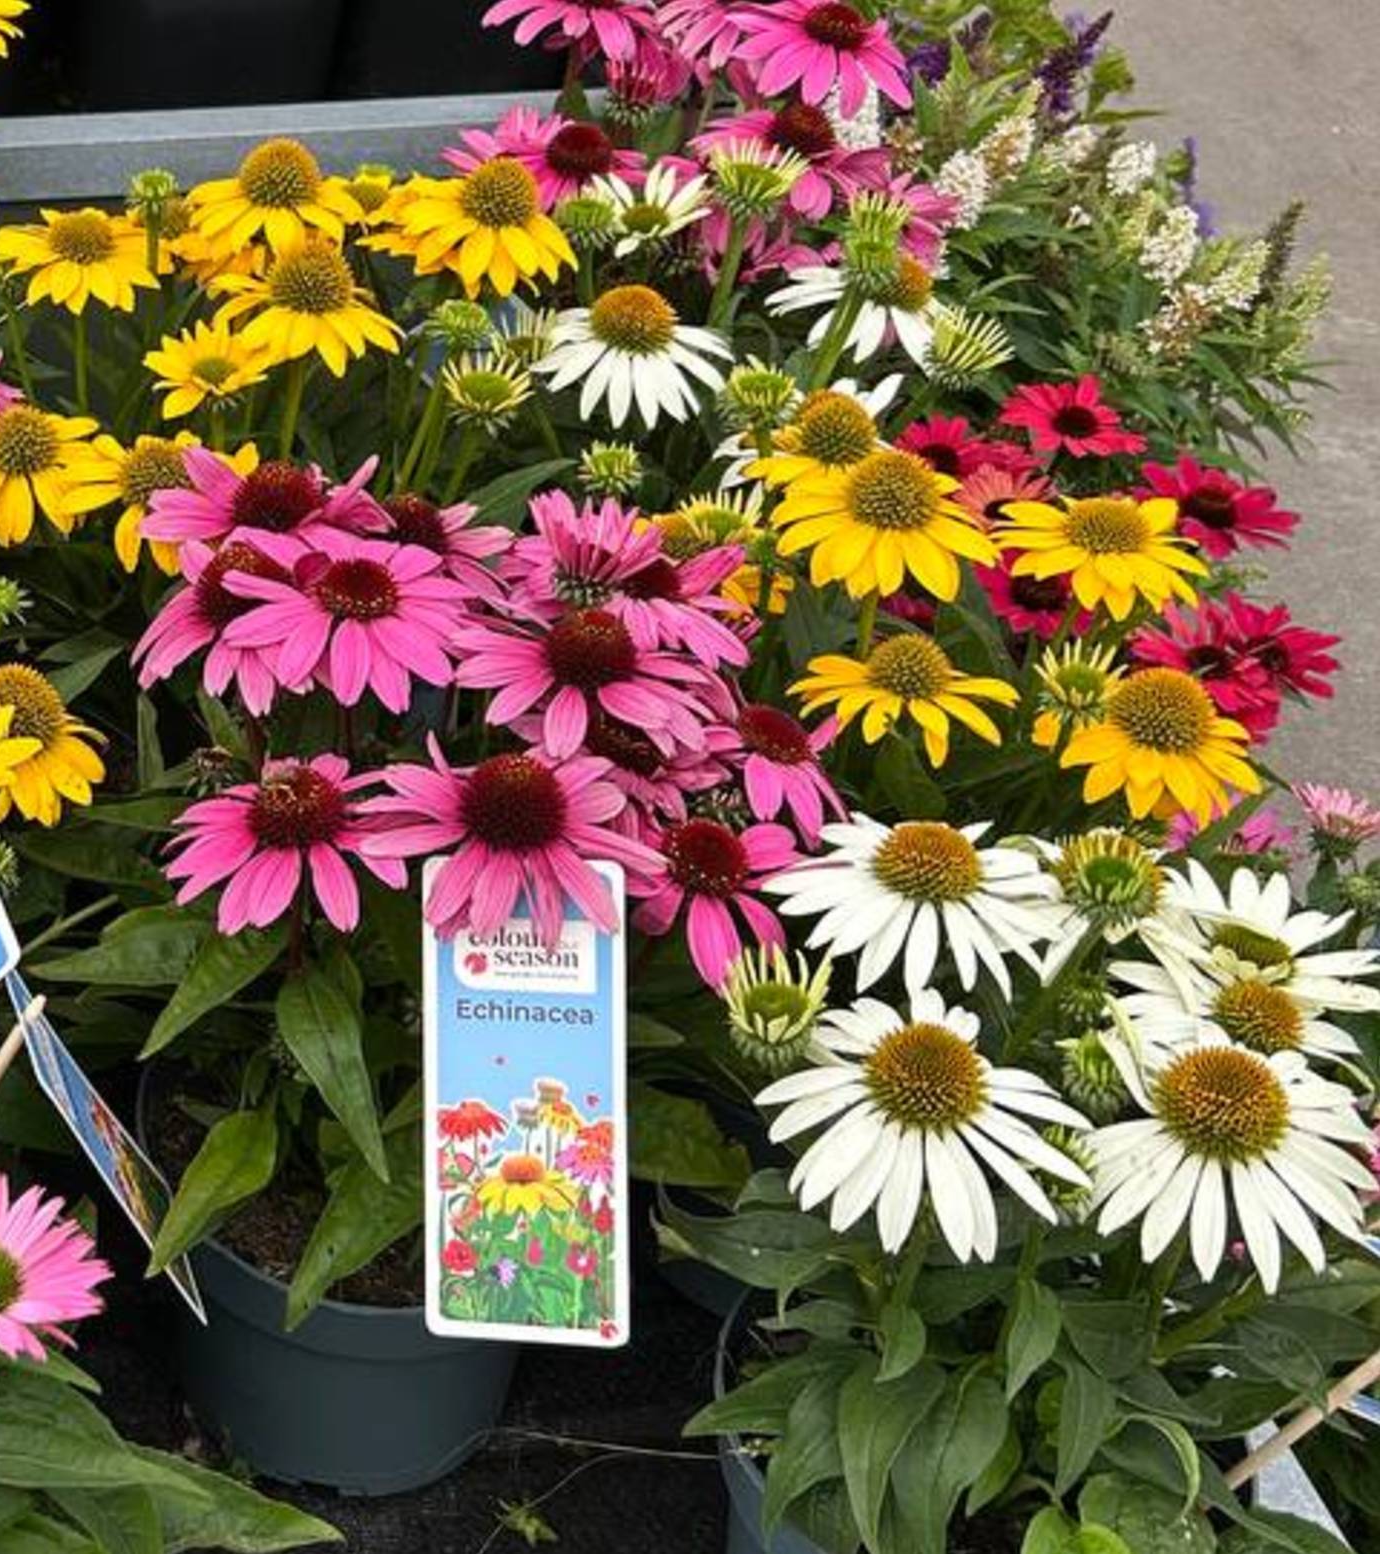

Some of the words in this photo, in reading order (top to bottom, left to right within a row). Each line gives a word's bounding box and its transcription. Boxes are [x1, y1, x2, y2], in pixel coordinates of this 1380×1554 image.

[468, 926, 546, 947] clou
[493, 950, 579, 968] season
[456, 998, 594, 1025] Echinacea
